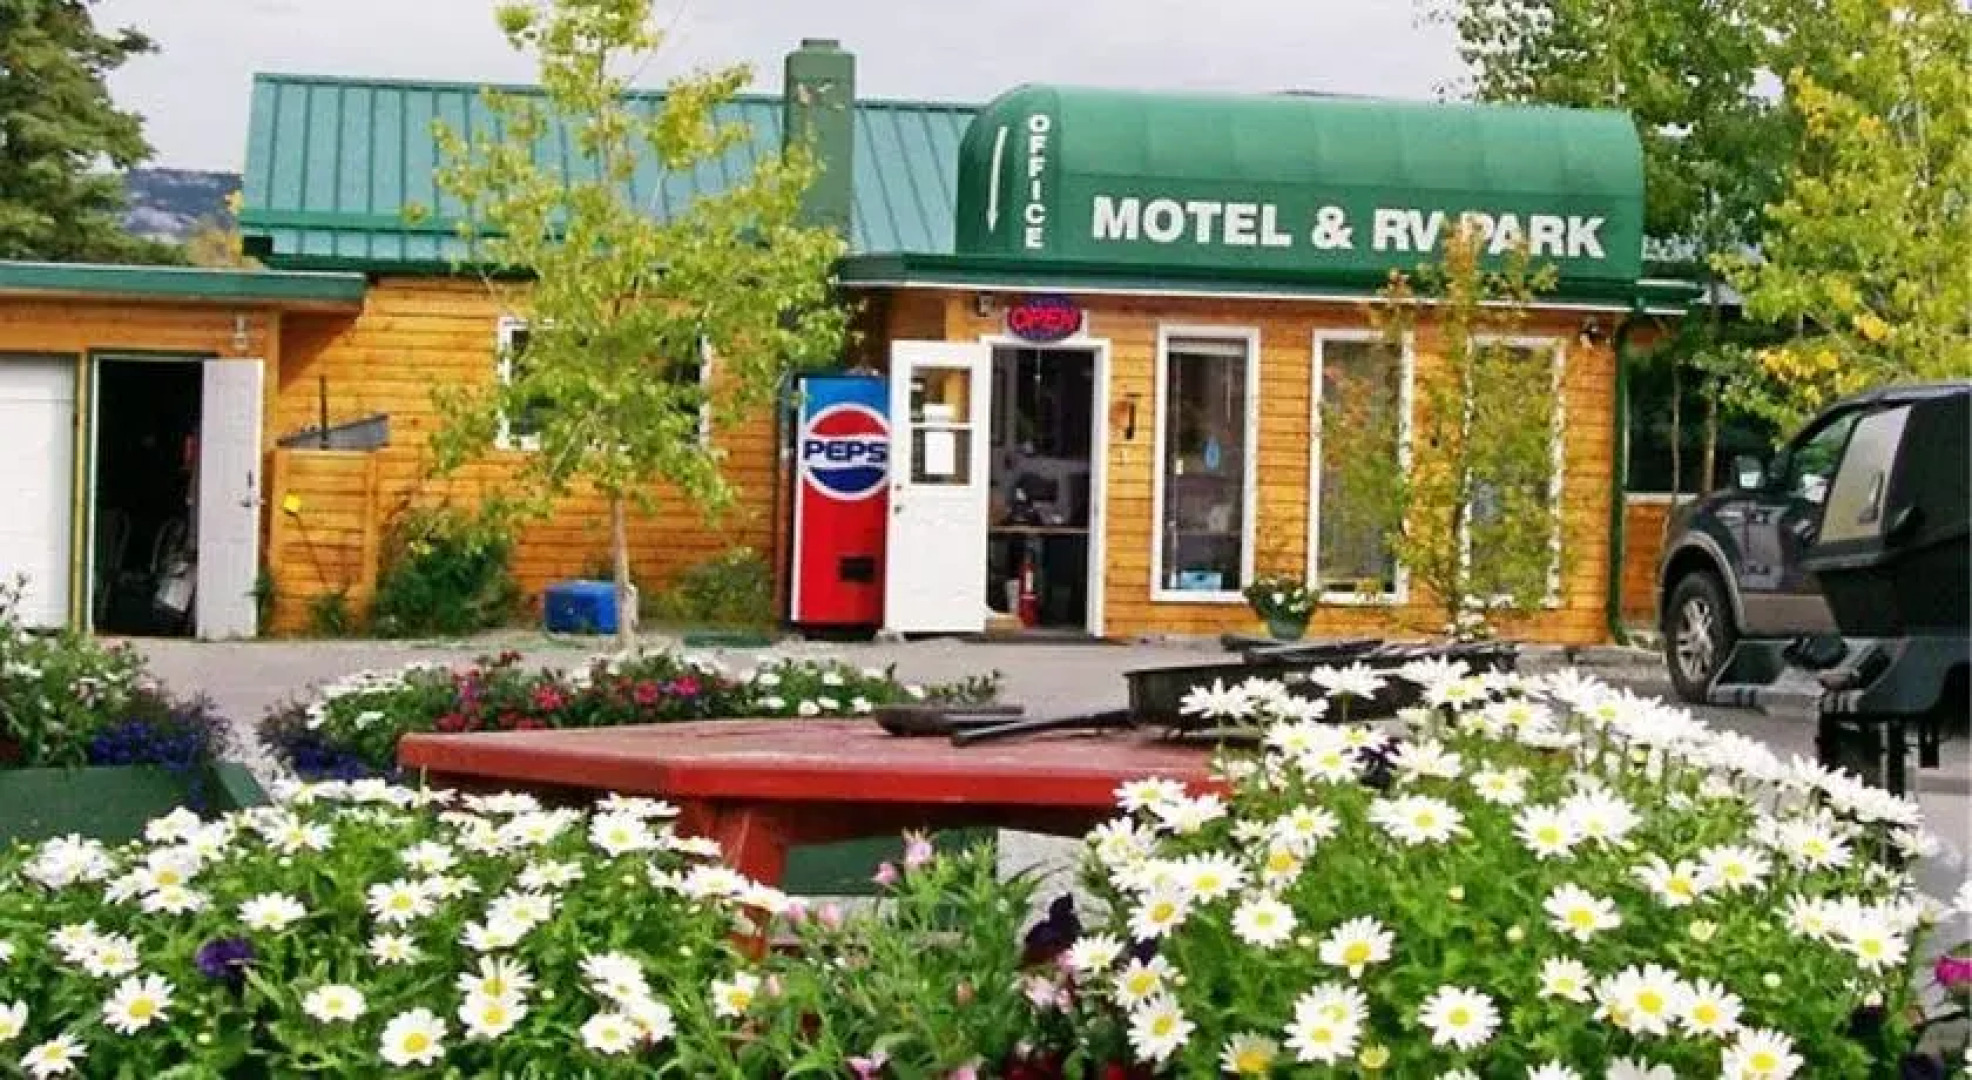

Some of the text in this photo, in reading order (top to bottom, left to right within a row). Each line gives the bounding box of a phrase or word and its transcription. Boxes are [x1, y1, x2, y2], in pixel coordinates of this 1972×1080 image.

[1024, 114, 1051, 249] OFFICE
[1092, 195, 1606, 258] MOTEL & RV PARK
[1010, 306, 1076, 331] OPEN
[803, 440, 888, 463] PEPS
